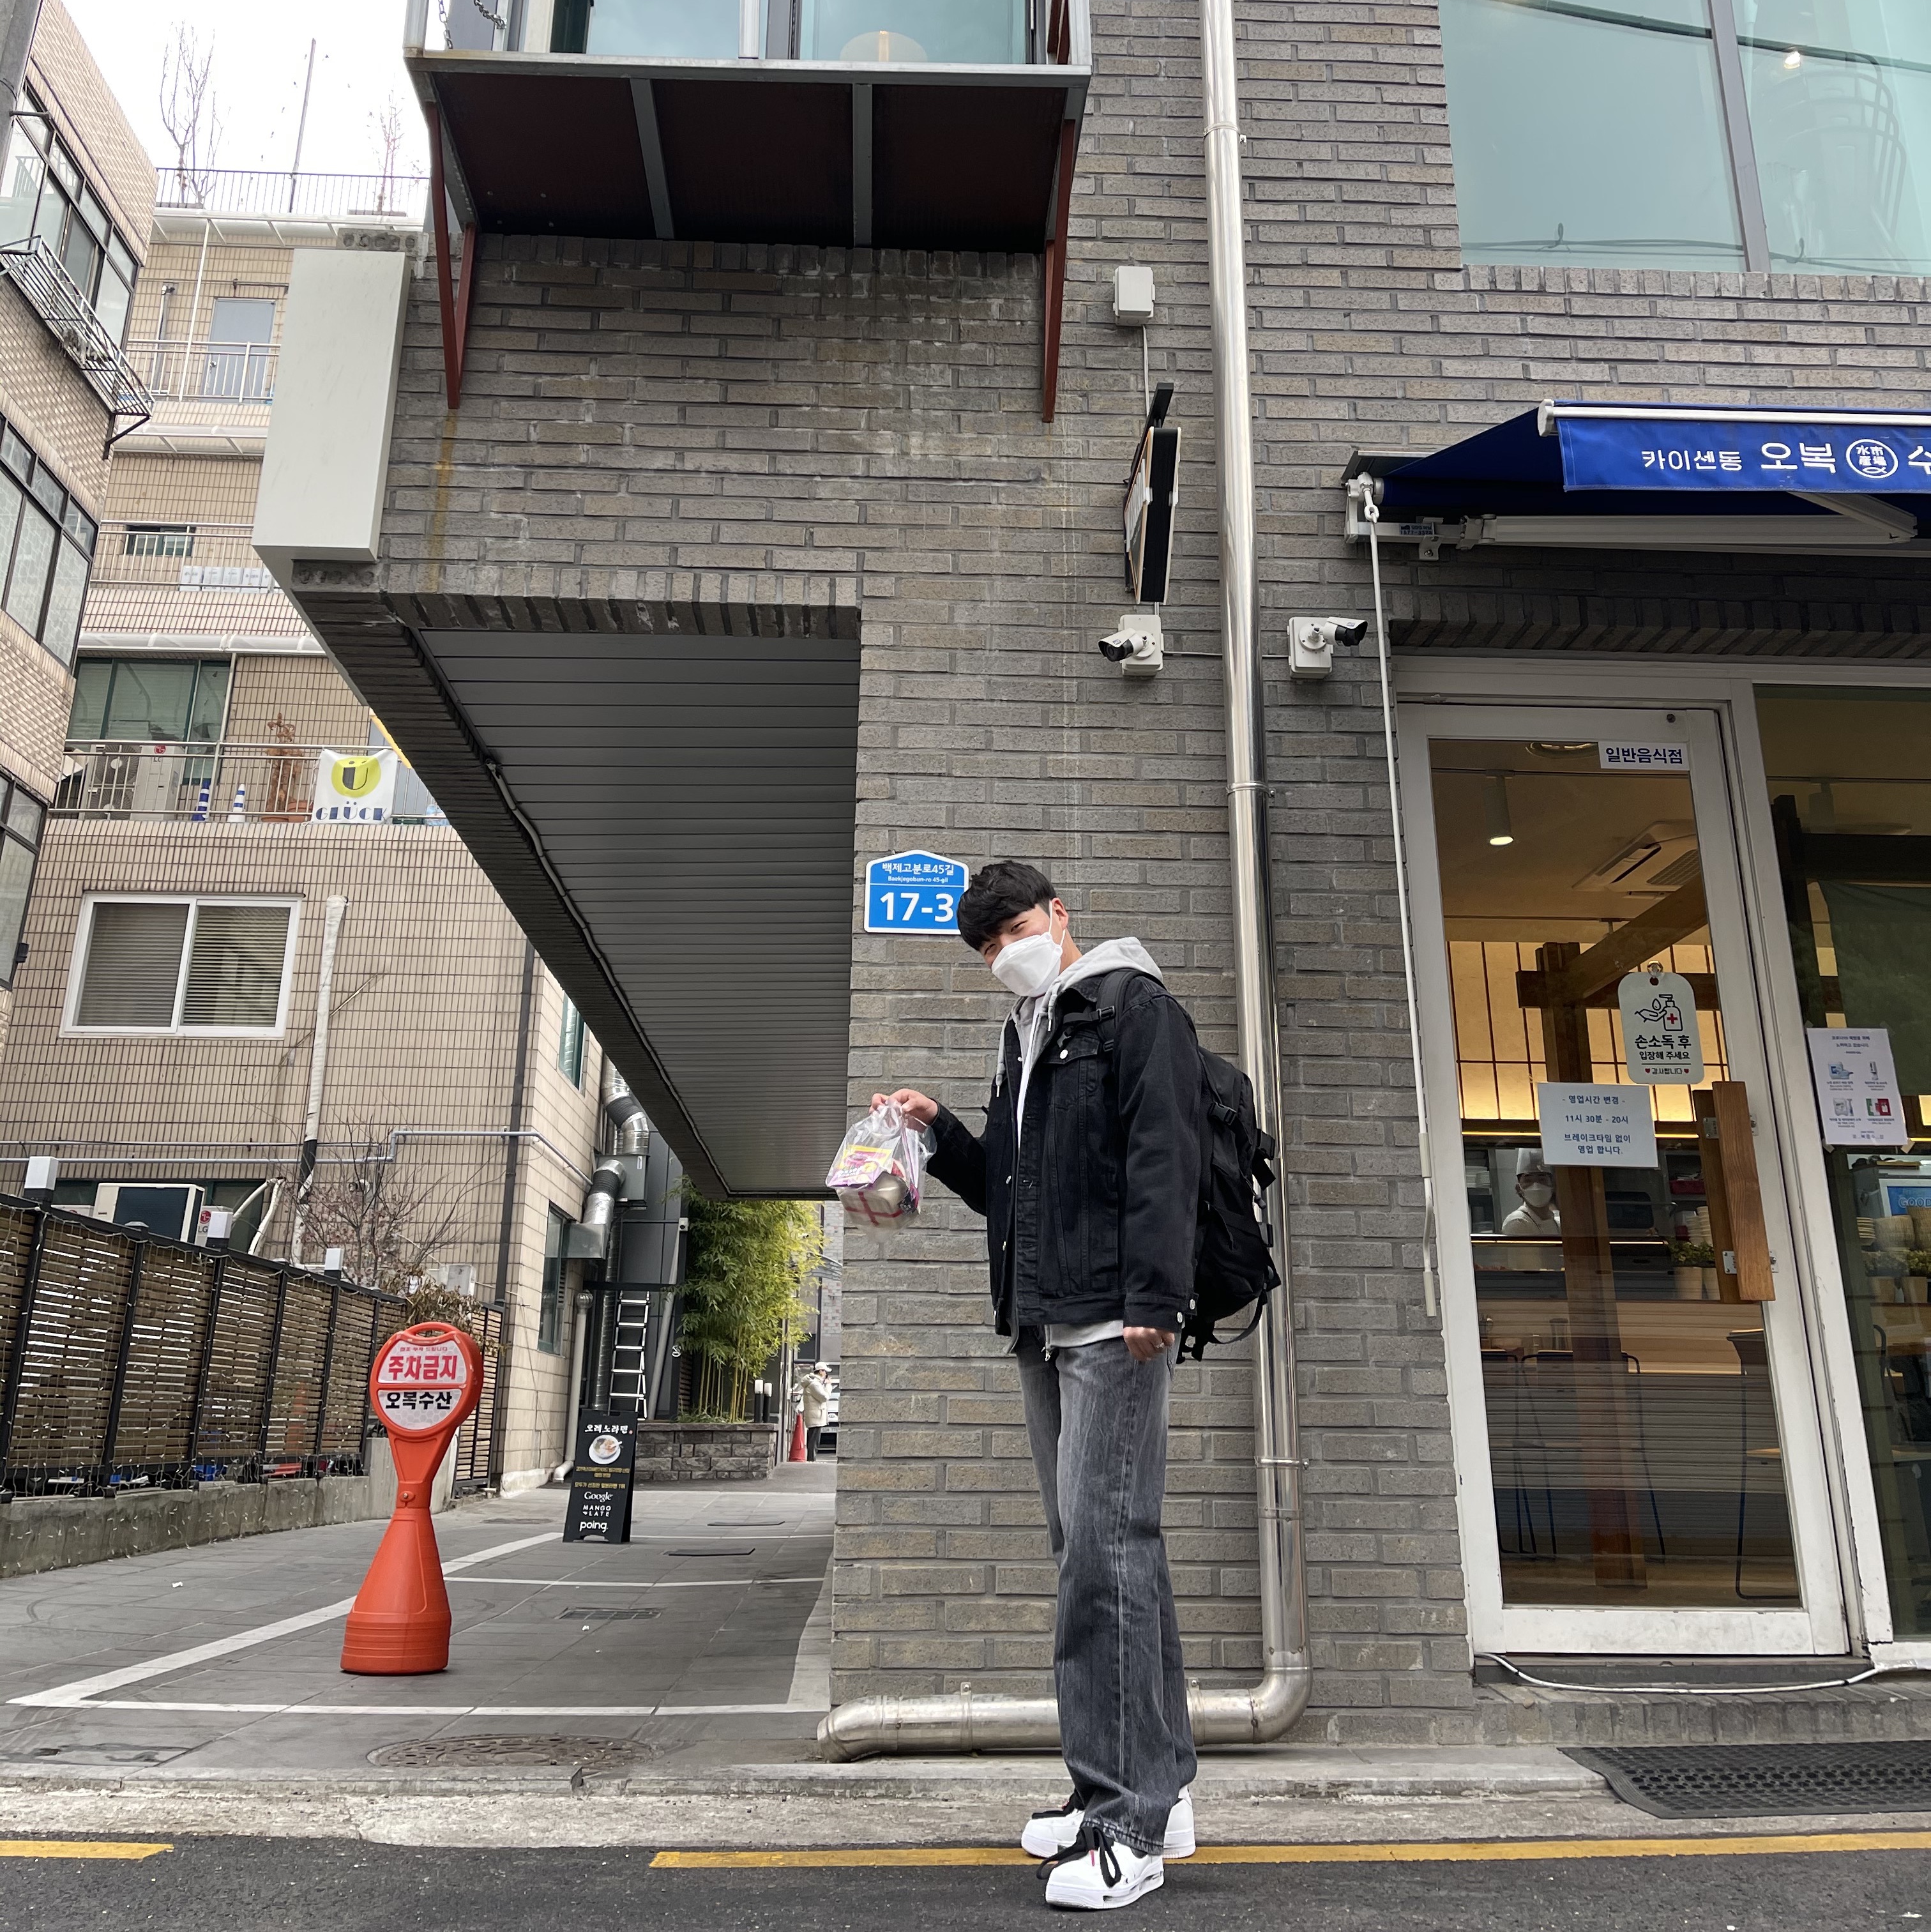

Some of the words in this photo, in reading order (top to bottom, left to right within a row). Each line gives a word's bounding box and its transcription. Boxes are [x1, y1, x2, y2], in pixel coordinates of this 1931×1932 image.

[1641, 450, 1742, 471] 카이센동
[1761, 442, 1836, 474] 오복
[1605, 747, 1683, 764] 일반음식점
[315, 801, 387, 821] GLÜCK
[882, 863, 954, 876] 백제고분로45길
[880, 892, 954, 923] 17-3
[1634, 1035, 1675, 1049] 손소독
[1677, 1035, 1692, 1049] 후
[1639, 1051, 1664, 1060] 입장해
[1666, 1051, 1690, 1060] 주세요
[1568, 1095, 1600, 1104] 영업시간
[1603, 1096, 1619, 1105] 변경
[1565, 1114, 1582, 1123] 11시
[1586, 1115, 1603, 1124] 30분
[1612, 1116, 1629, 1124] 20시
[1564, 1134, 1612, 1143] 브레이크타임
[1616, 1134, 1631, 1143] 없이
[1577, 1145, 1593, 1154] 영업
[388, 1355, 458, 1380] 주차금지
[386, 1392, 452, 1410] 오복수산
[584, 1491, 613, 1503] Google
